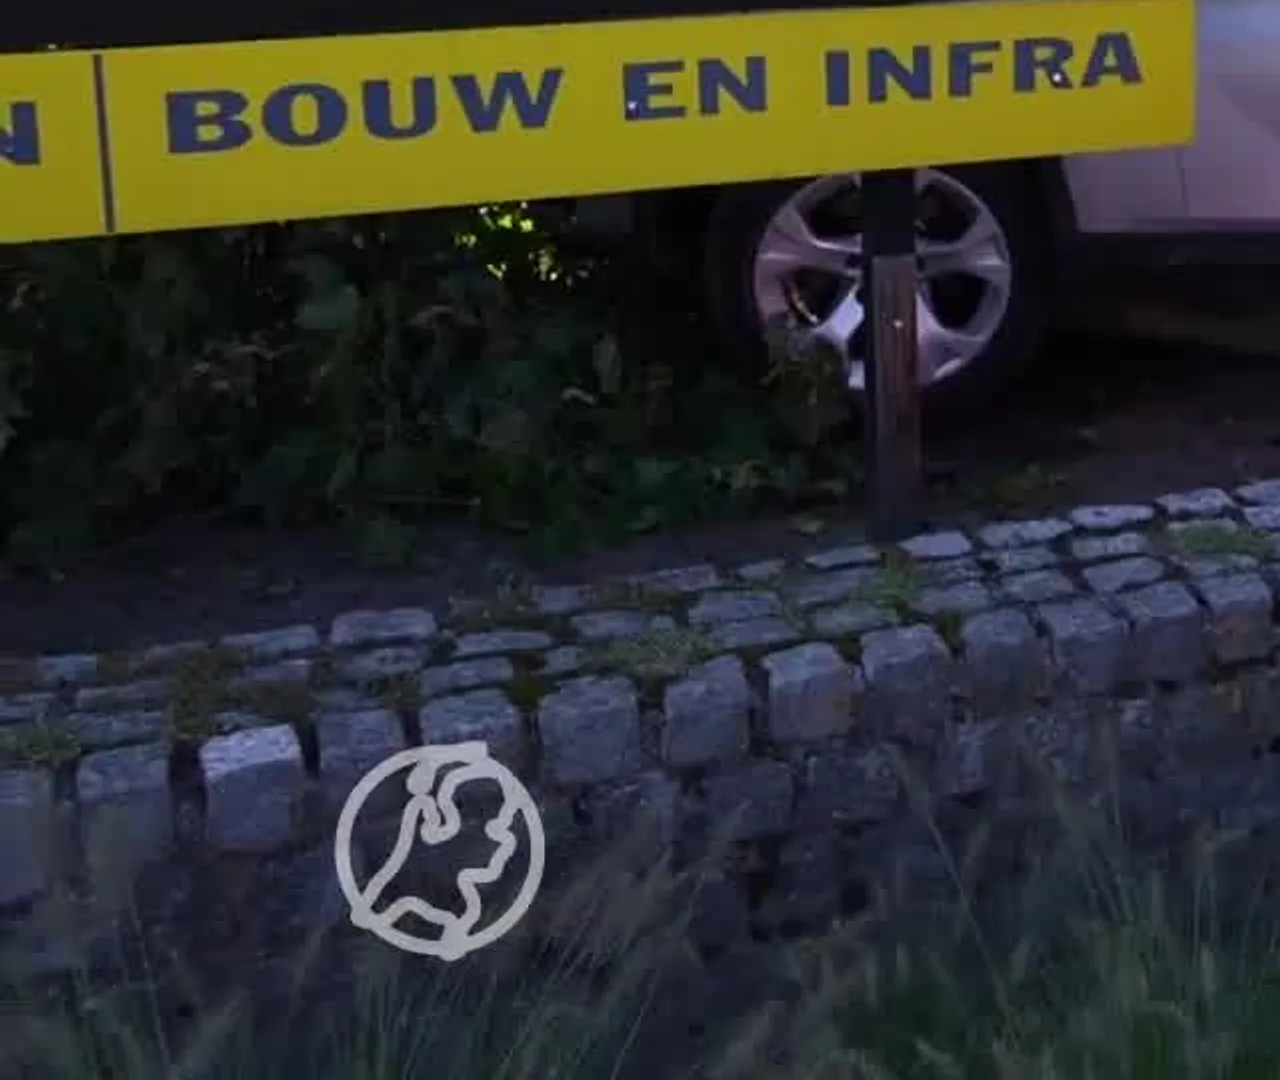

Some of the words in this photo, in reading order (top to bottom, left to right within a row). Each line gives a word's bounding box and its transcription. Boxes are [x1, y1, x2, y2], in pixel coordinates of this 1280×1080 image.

[165, 69, 563, 153] BOUW
[622, 55, 767, 121] EN
[825, 31, 1142, 106] INFRA
